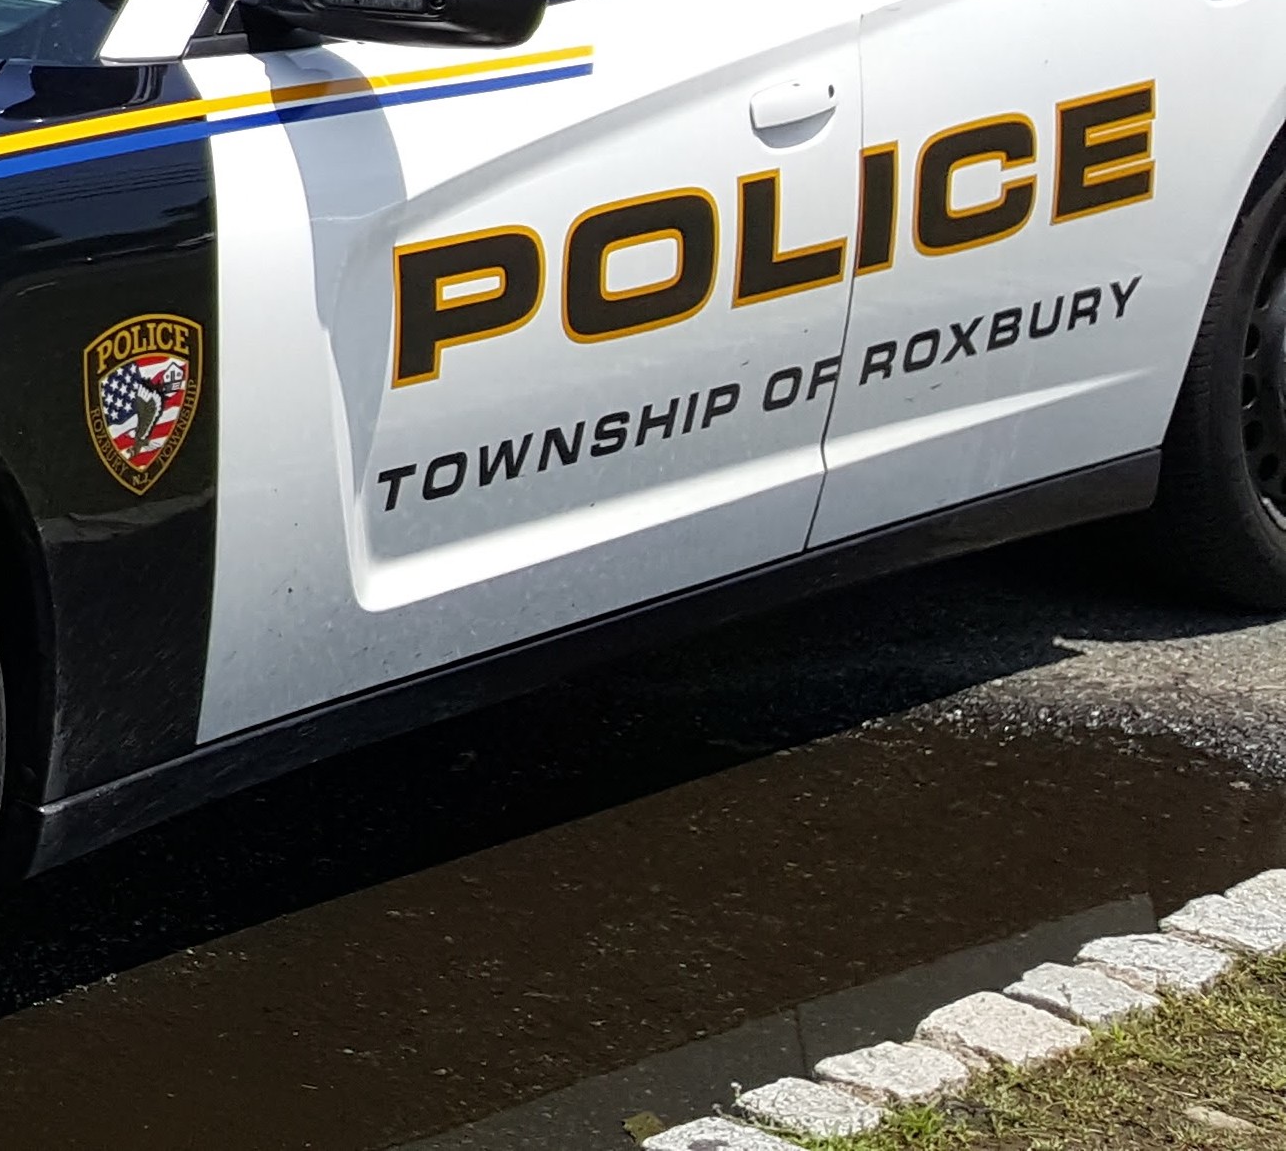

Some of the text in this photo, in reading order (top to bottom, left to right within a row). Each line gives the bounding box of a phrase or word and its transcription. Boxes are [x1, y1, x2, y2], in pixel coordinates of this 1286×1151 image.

[390, 78, 1158, 390] POLICE
[96, 321, 190, 375] POLICE
[157, 378, 198, 467] TOWNSHIP
[376, 275, 1143, 513] TOWNSHIP OF ROXBURY
[90, 406, 128, 476] ROXBURY
